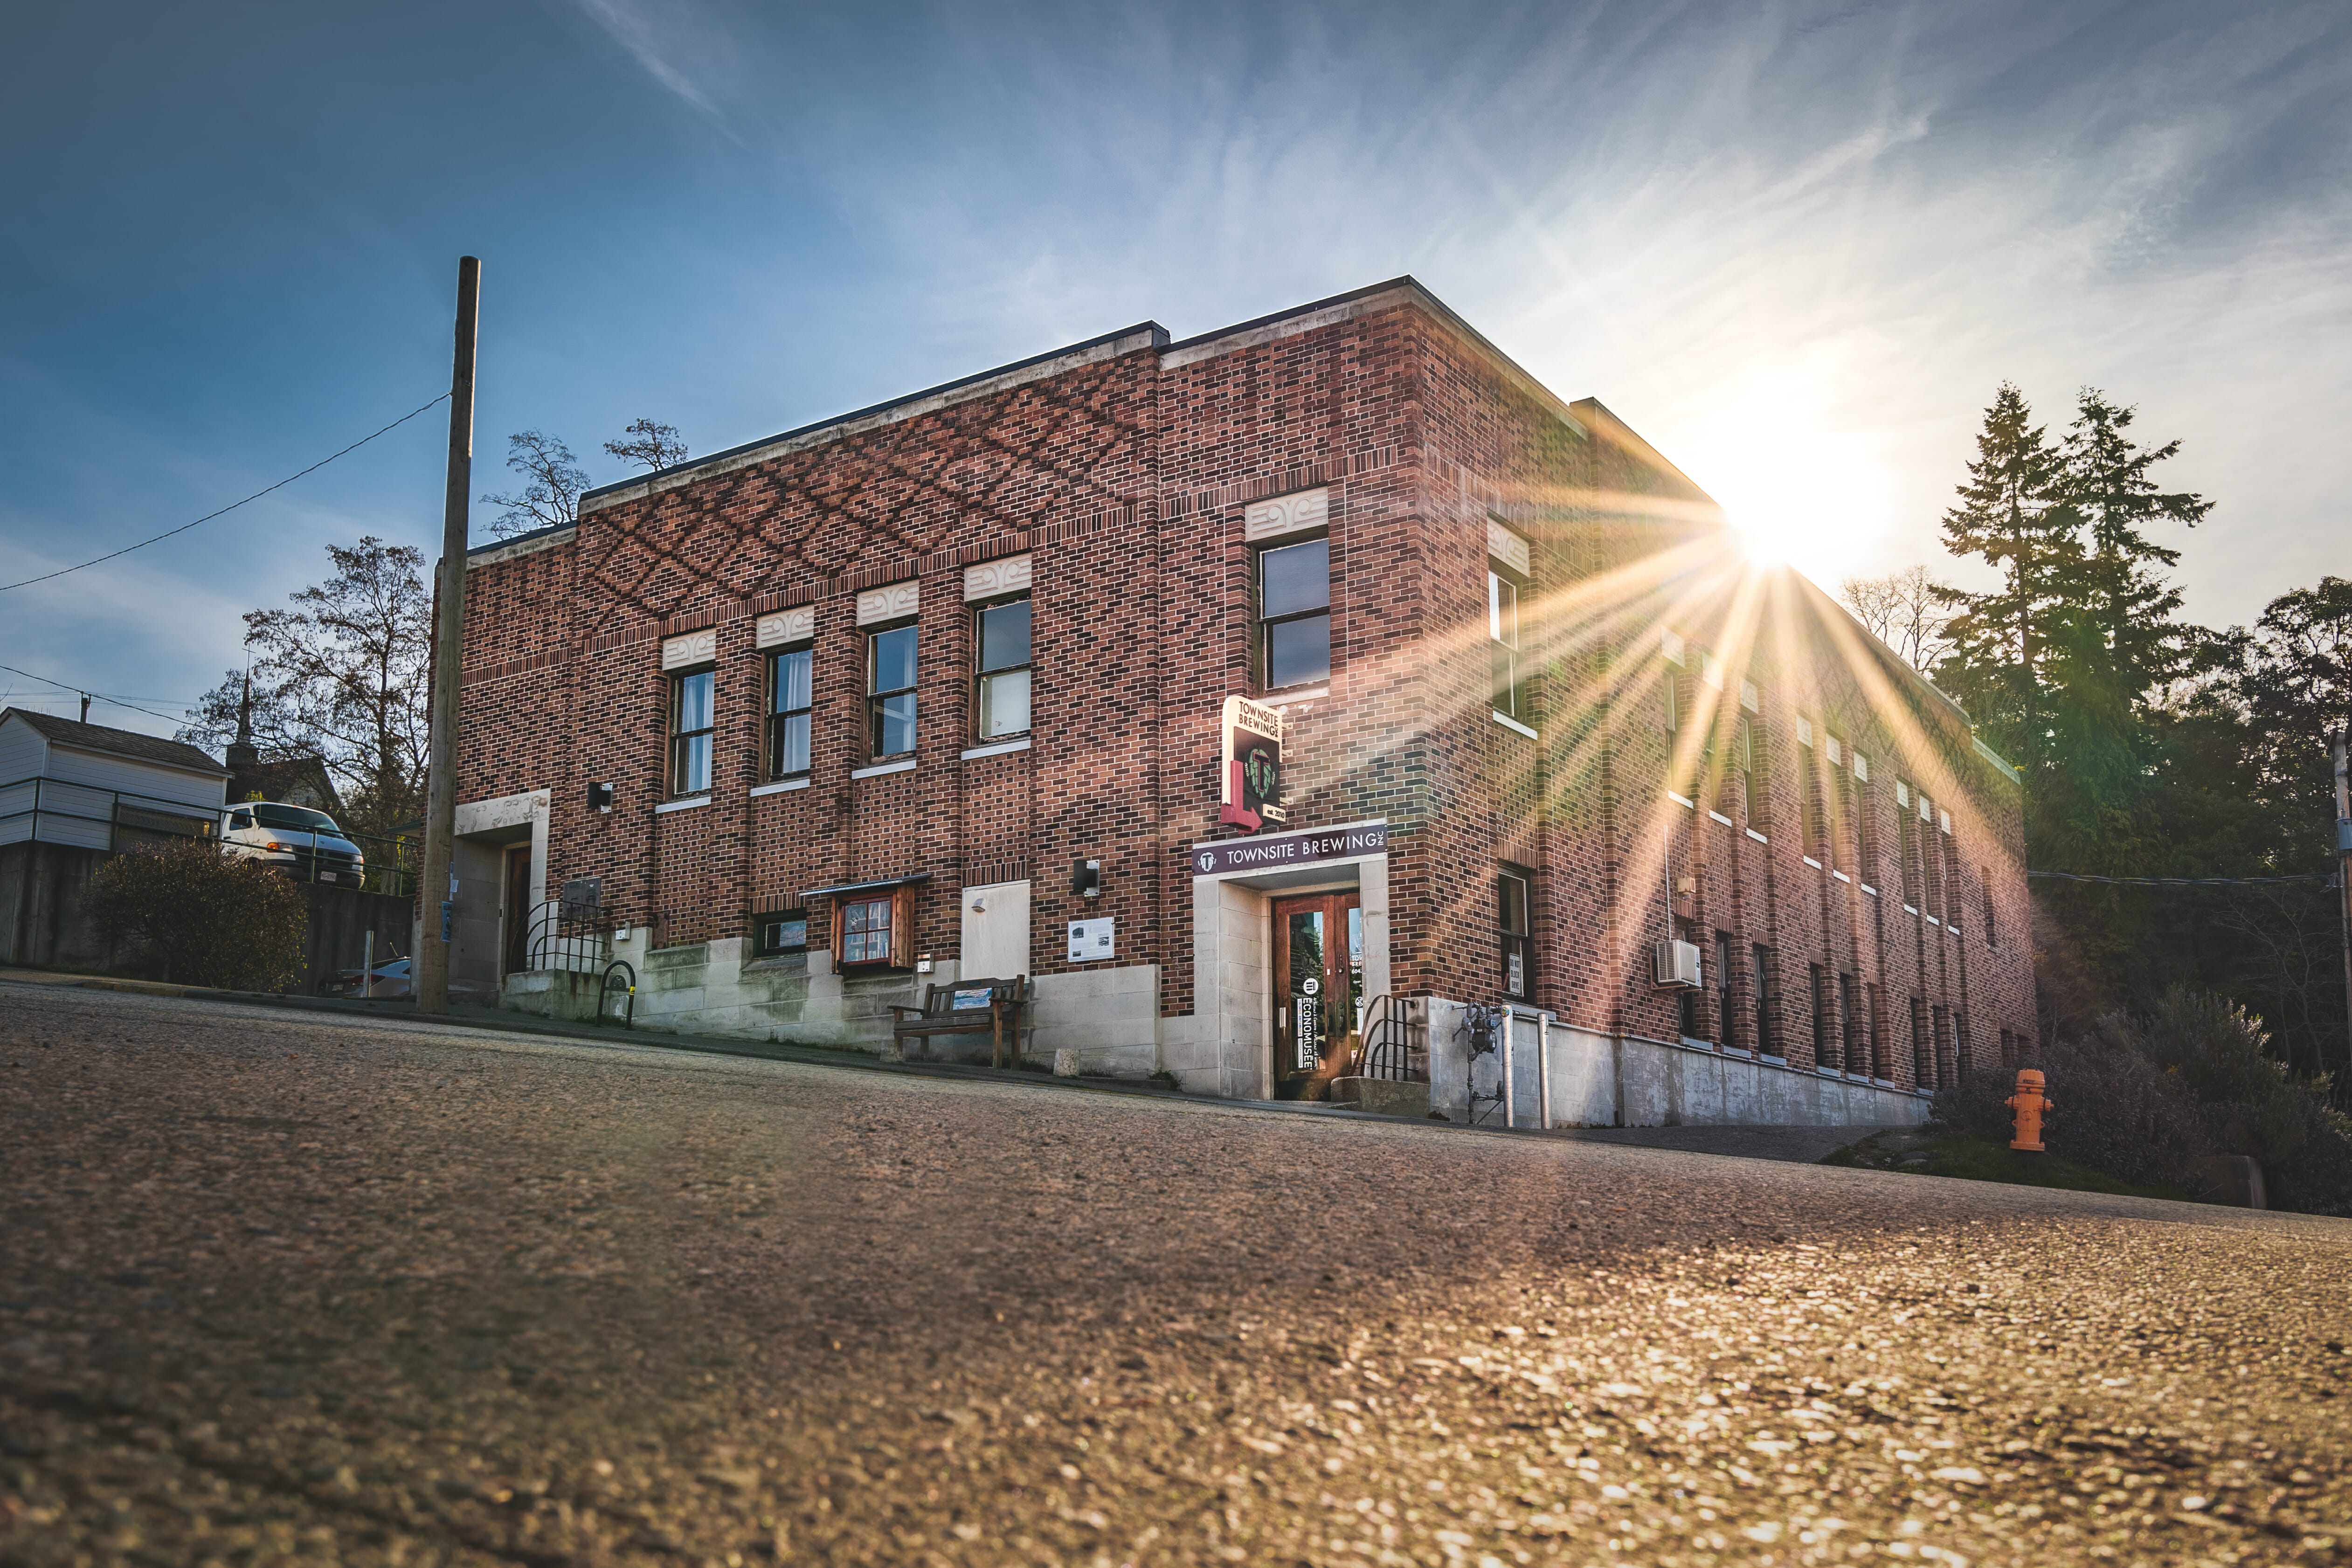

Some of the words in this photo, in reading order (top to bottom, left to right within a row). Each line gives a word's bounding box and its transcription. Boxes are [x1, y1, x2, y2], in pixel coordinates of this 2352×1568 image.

[1239, 701, 1278, 727] TOWNSITE
[1239, 713, 1275, 736] BREWING
[1275, 810, 1285, 818] 2010
[1227, 843, 1294, 864] TOWNSITE
[1302, 833, 1377, 855] BREWING
[1511, 970, 1519, 979] BLOCK
